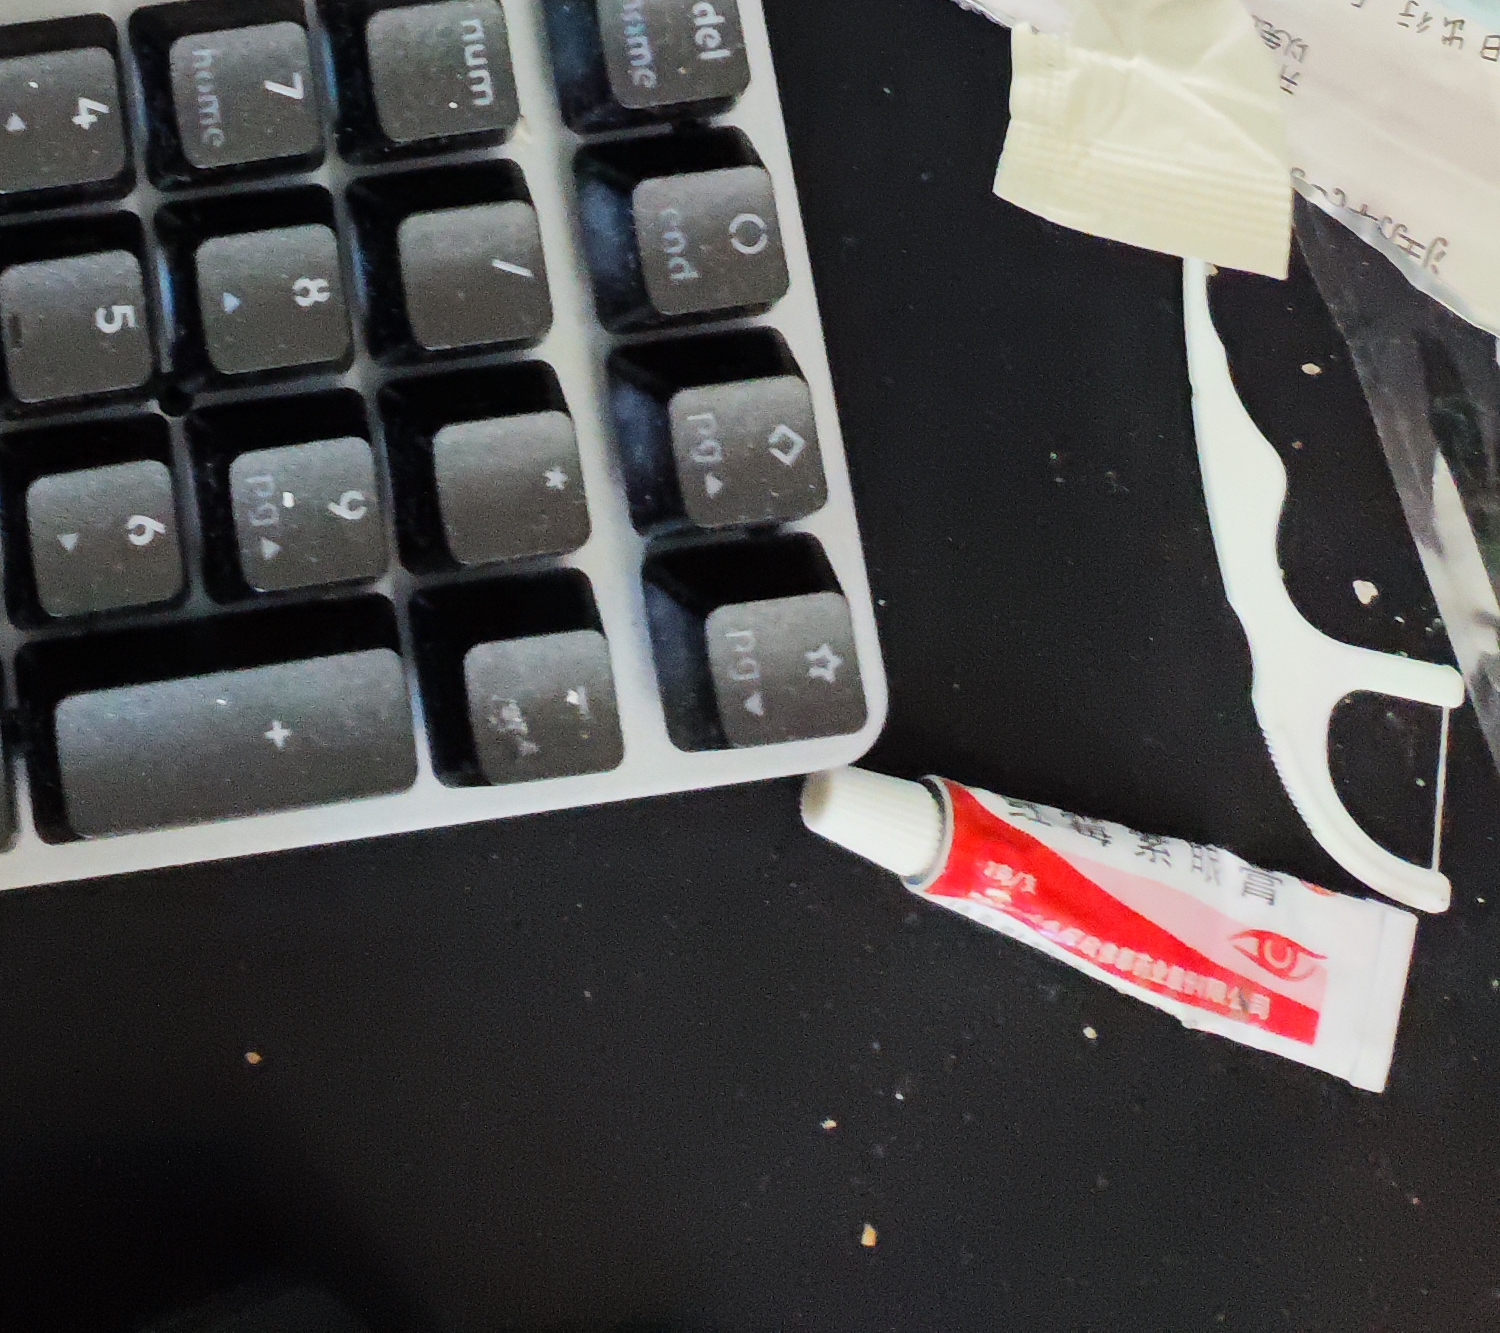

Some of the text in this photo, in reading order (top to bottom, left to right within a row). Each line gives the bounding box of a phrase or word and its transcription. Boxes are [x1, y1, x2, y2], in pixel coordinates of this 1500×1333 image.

[691, 0, 731, 60] del
[459, 17, 497, 107] num
[192, 48, 227, 147] home
[264, 72, 304, 100] 7
[72, 97, 109, 130] 4
[292, 277, 331, 307] 8
[95, 304, 136, 334] 5
[327, 489, 367, 521] 9
[126, 514, 166, 546] 6
